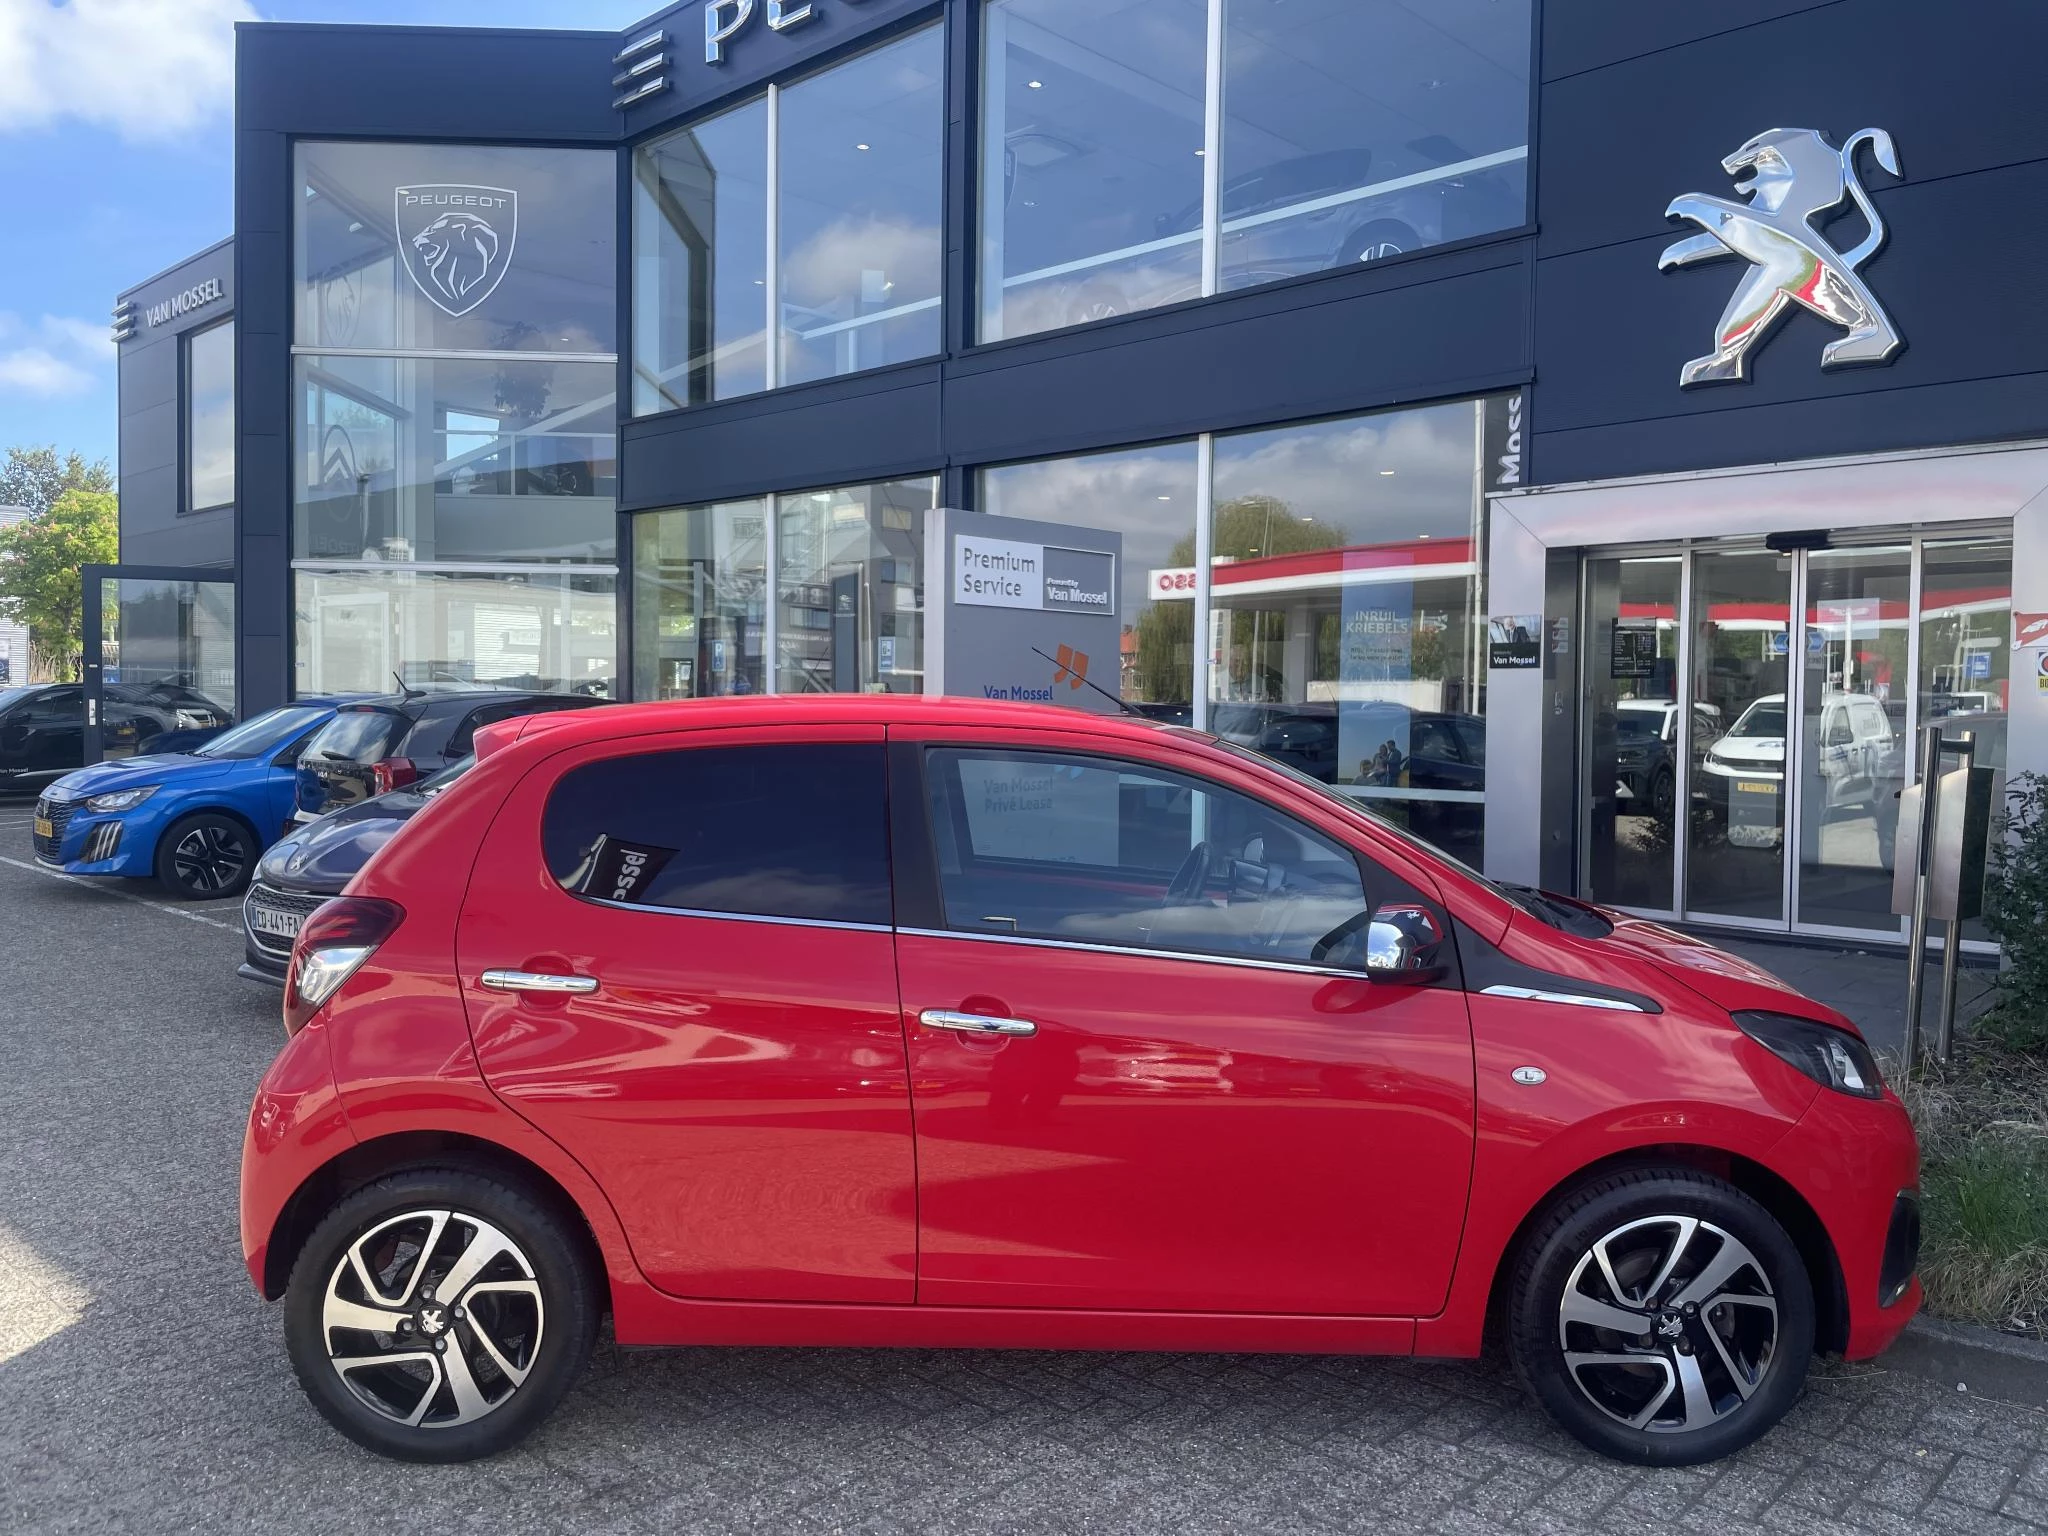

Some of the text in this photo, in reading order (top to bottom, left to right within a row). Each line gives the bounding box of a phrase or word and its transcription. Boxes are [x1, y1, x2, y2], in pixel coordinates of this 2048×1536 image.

[406, 194, 506, 209] PEUGEOT
[146, 278, 223, 327] VAN MOSSEL
[963, 547, 1036, 573] Premium
[963, 574, 1023, 597] Service
[1047, 586, 1108, 605] Van Mossel
[1355, 610, 1399, 622] INRUIL
[1346, 622, 1408, 634] KRIEBELS
[1493, 655, 1536, 665] Van Mossel
[984, 685, 1054, 701] Van Mossel
[983, 776, 1053, 795] Van Mossel
[1020, 796, 1053, 811] Lease
